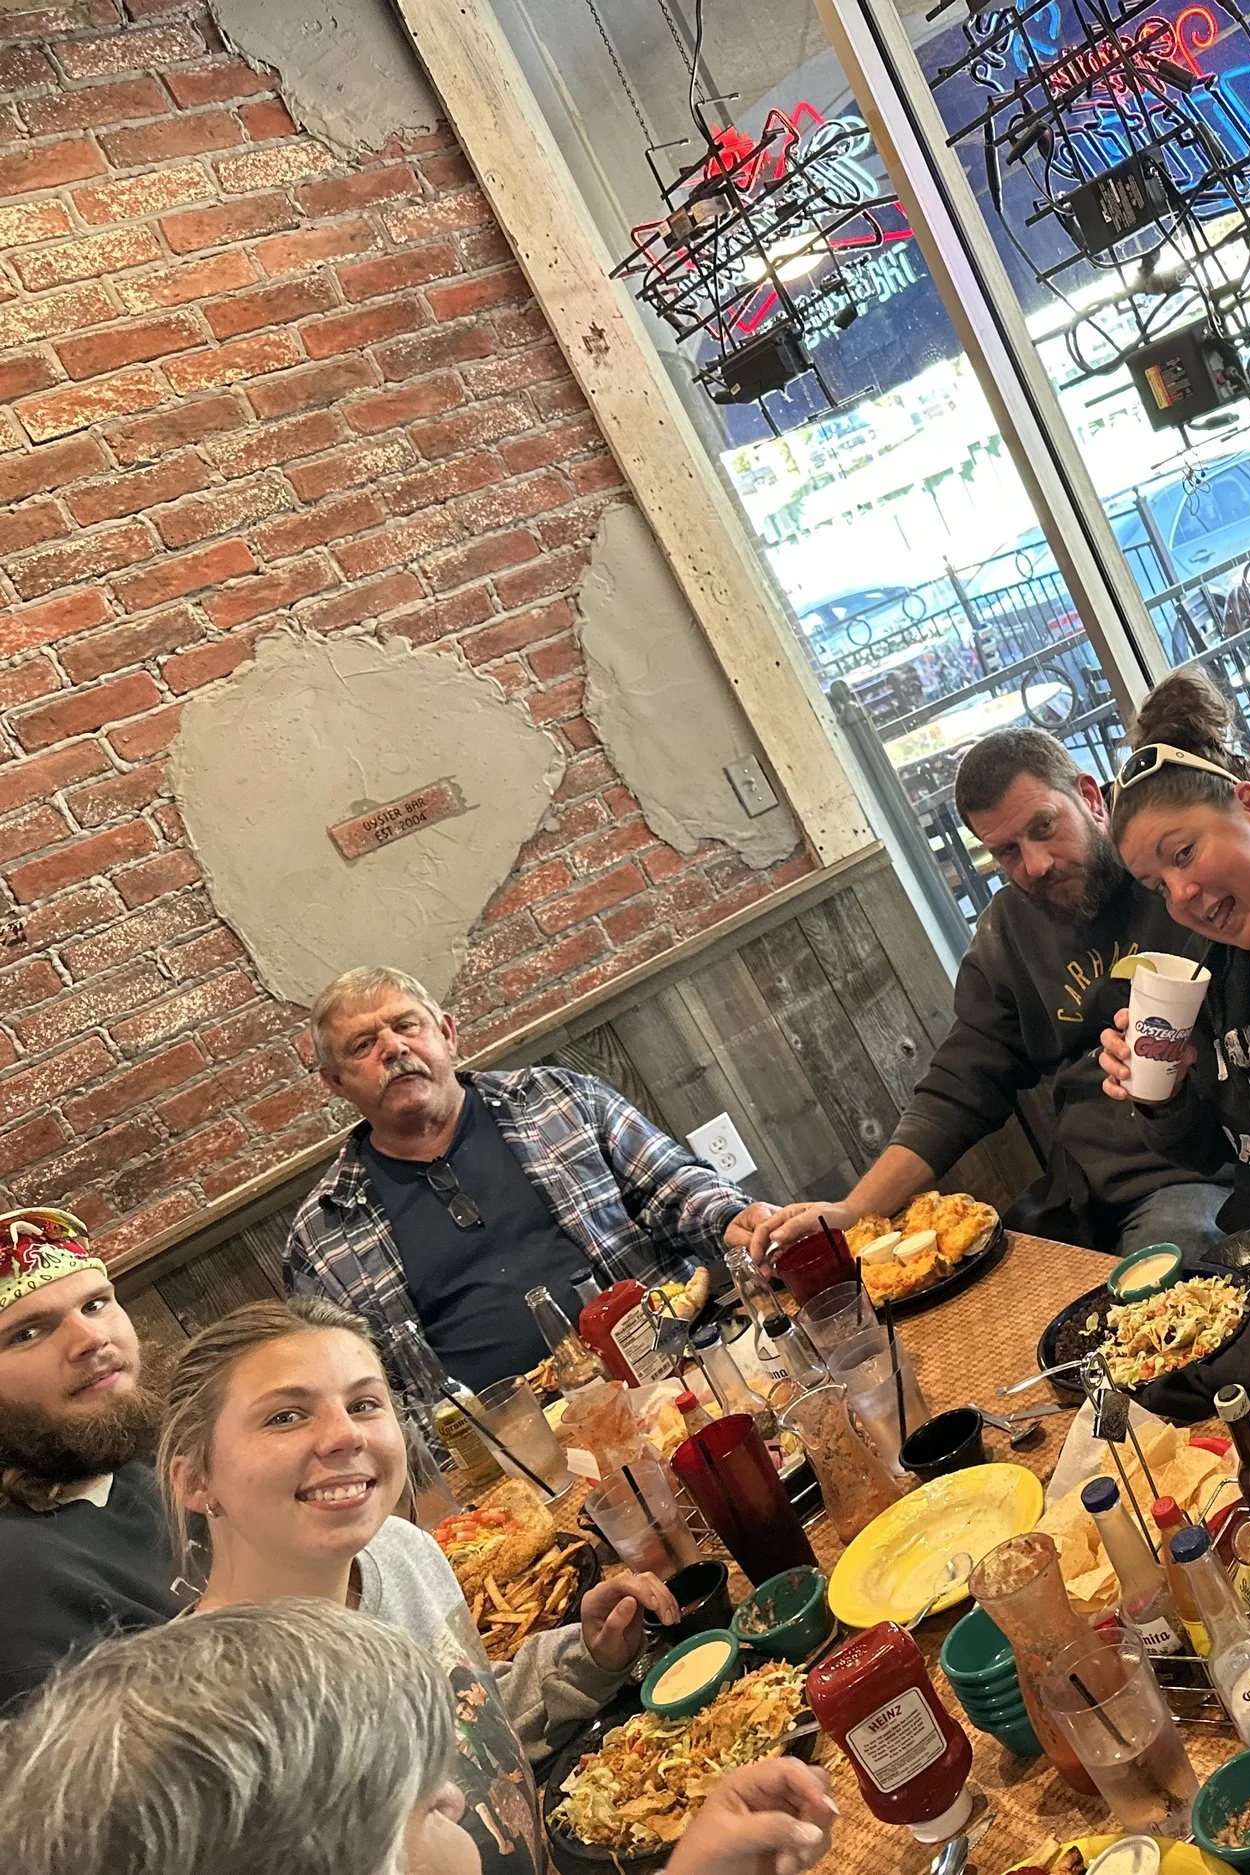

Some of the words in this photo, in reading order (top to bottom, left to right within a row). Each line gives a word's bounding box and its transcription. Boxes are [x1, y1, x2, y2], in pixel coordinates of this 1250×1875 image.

[362, 808, 402, 832] OYSTER
[404, 797, 428, 813] BAR
[399, 812, 428, 831] 2004
[1135, 1020, 1178, 1042] OYSTER
[868, 1705, 903, 1733] HEINZ
